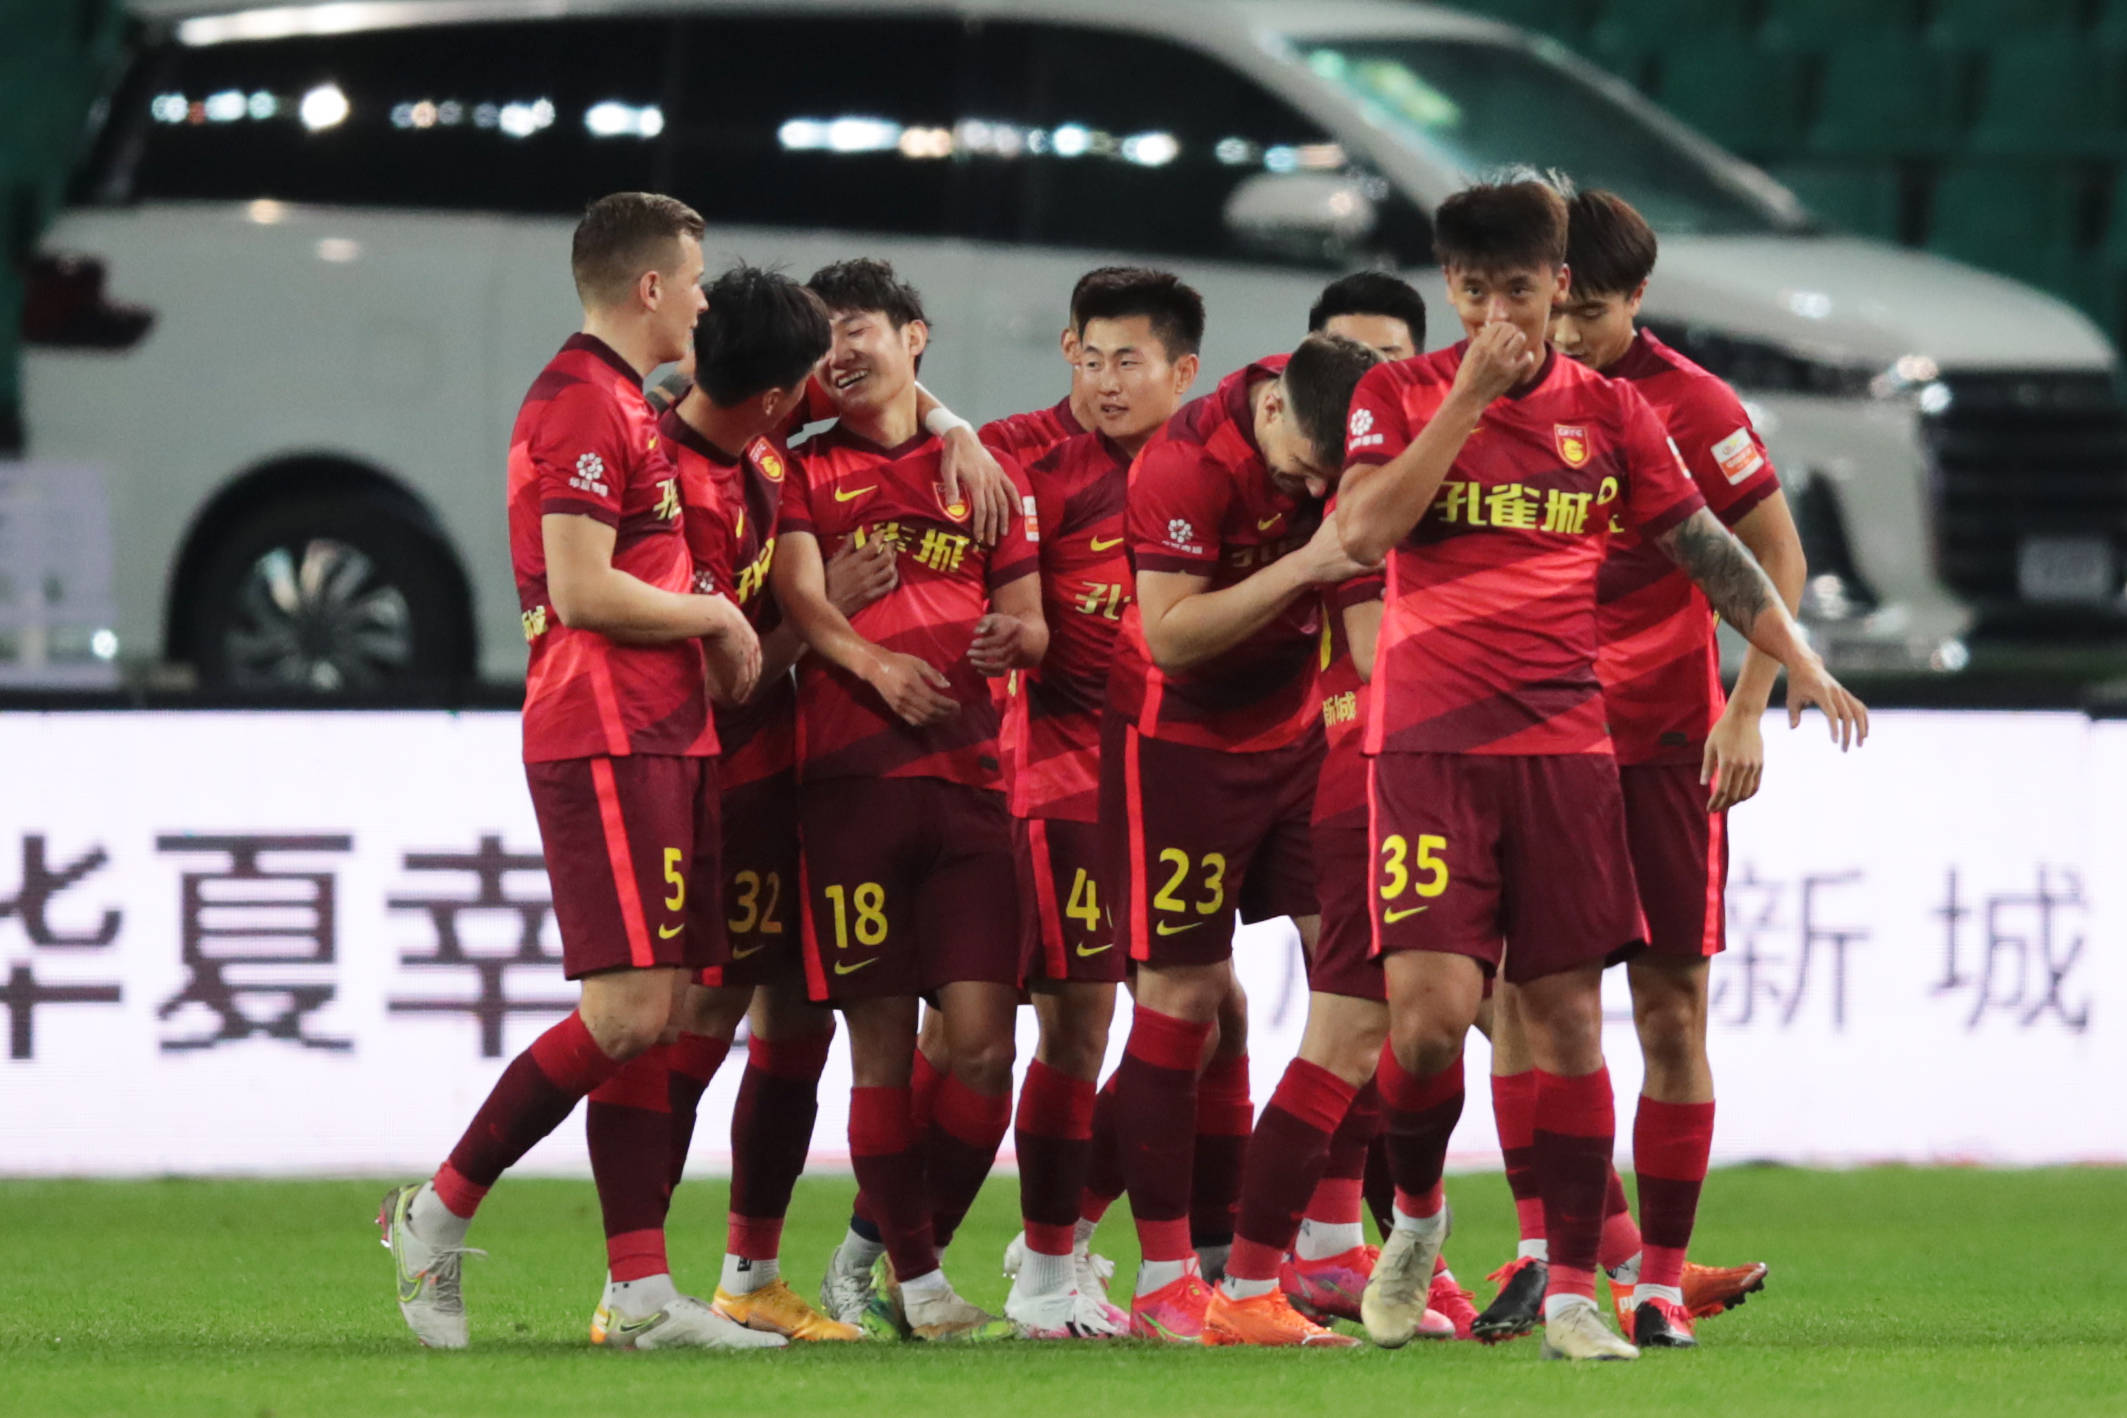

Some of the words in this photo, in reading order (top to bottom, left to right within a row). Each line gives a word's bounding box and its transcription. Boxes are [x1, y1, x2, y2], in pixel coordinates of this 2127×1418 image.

[1432, 476, 1617, 534] 孔雀城
[664, 847, 685, 911] 5
[1153, 848, 1226, 914] 23
[1380, 834, 1449, 900] 35
[728, 870, 782, 933] 32
[825, 882, 888, 948] 18
[1066, 868, 1113, 931] 4
